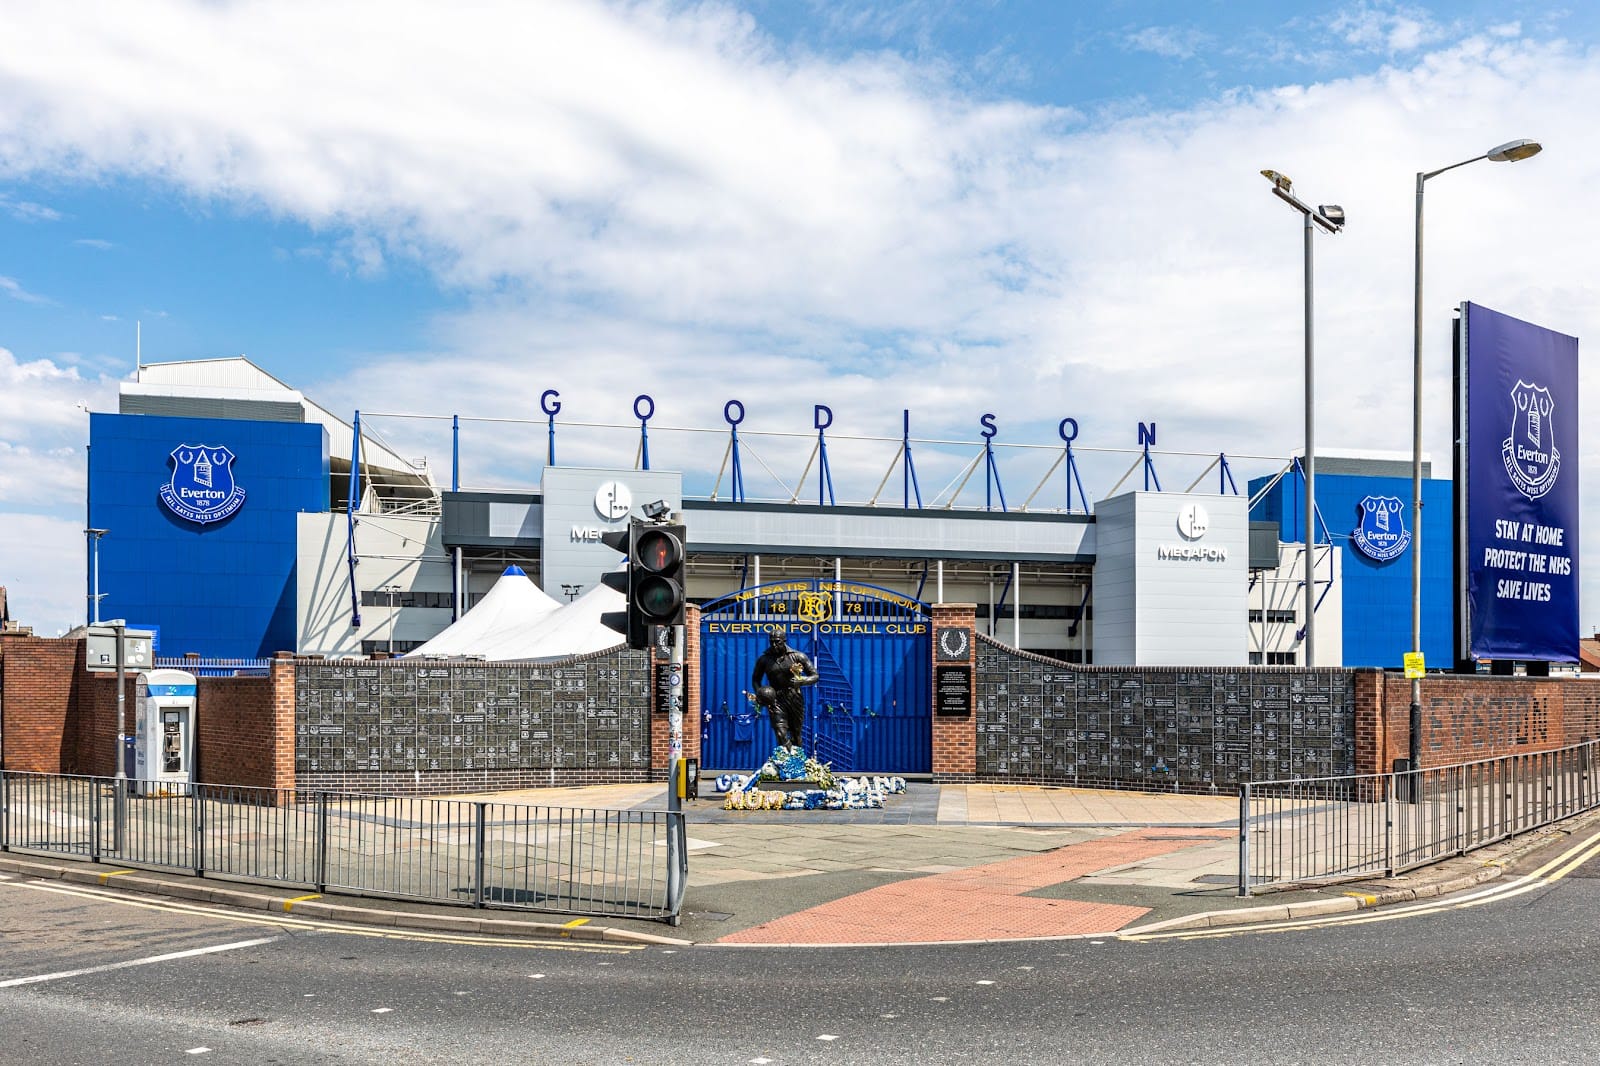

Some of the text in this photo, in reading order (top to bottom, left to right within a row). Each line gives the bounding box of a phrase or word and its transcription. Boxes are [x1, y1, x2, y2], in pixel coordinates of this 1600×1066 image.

[540, 389, 1156, 446] GOODISON
[1517, 444, 1548, 464] Everton
[180, 487, 226, 499] Everton
[165, 495, 175, 507] NIL
[175, 505, 194, 518] SATIS
[212, 497, 240, 519] OPTIMUM
[196, 499, 210, 507] 1878
[1367, 530, 1398, 541] Everton
[1495, 519, 1564, 546] STAY AT HOME
[1157, 545, 1228, 562] MEGAFON
[1484, 547, 1571, 576] PROTECT THE NHS
[761, 583, 808, 595] SATIS
[819, 583, 847, 592] NISI
[1496, 579, 1551, 602] SAVE LIVES
[771, 603, 862, 613] 18 78
[709, 623, 786, 633] EVERTON
[885, 623, 927, 634] CLUB
